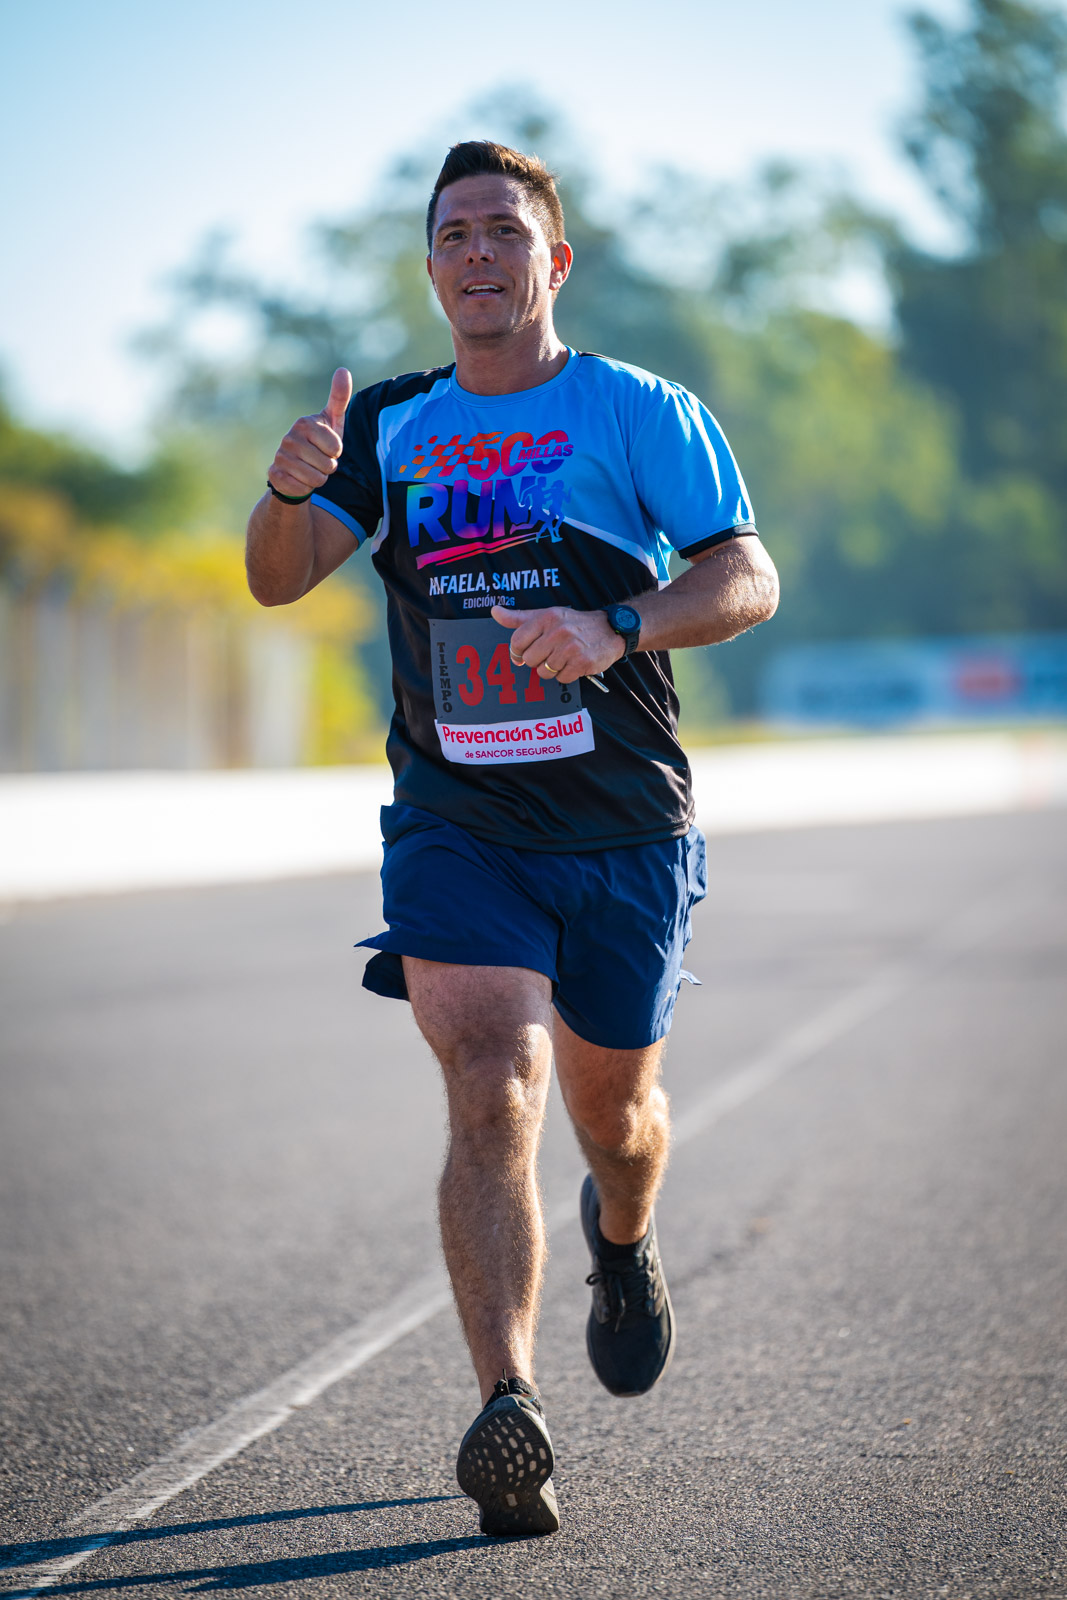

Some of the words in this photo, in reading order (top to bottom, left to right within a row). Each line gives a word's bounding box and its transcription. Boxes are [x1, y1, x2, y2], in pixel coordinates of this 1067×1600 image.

[518, 444, 574, 461] MILLAS
[406, 476, 537, 549] RUN
[492, 569, 541, 591] SANTA
[543, 568, 561, 587] FE
[463, 594, 497, 609] EDICIÓN
[436, 641, 453, 713] TIEMPO
[442, 725, 532, 744] Prevención
[534, 715, 584, 740] Salud
[465, 750, 474, 759] de
[475, 749, 514, 759] SANCOR
[516, 745, 562, 757] SEGUROS
